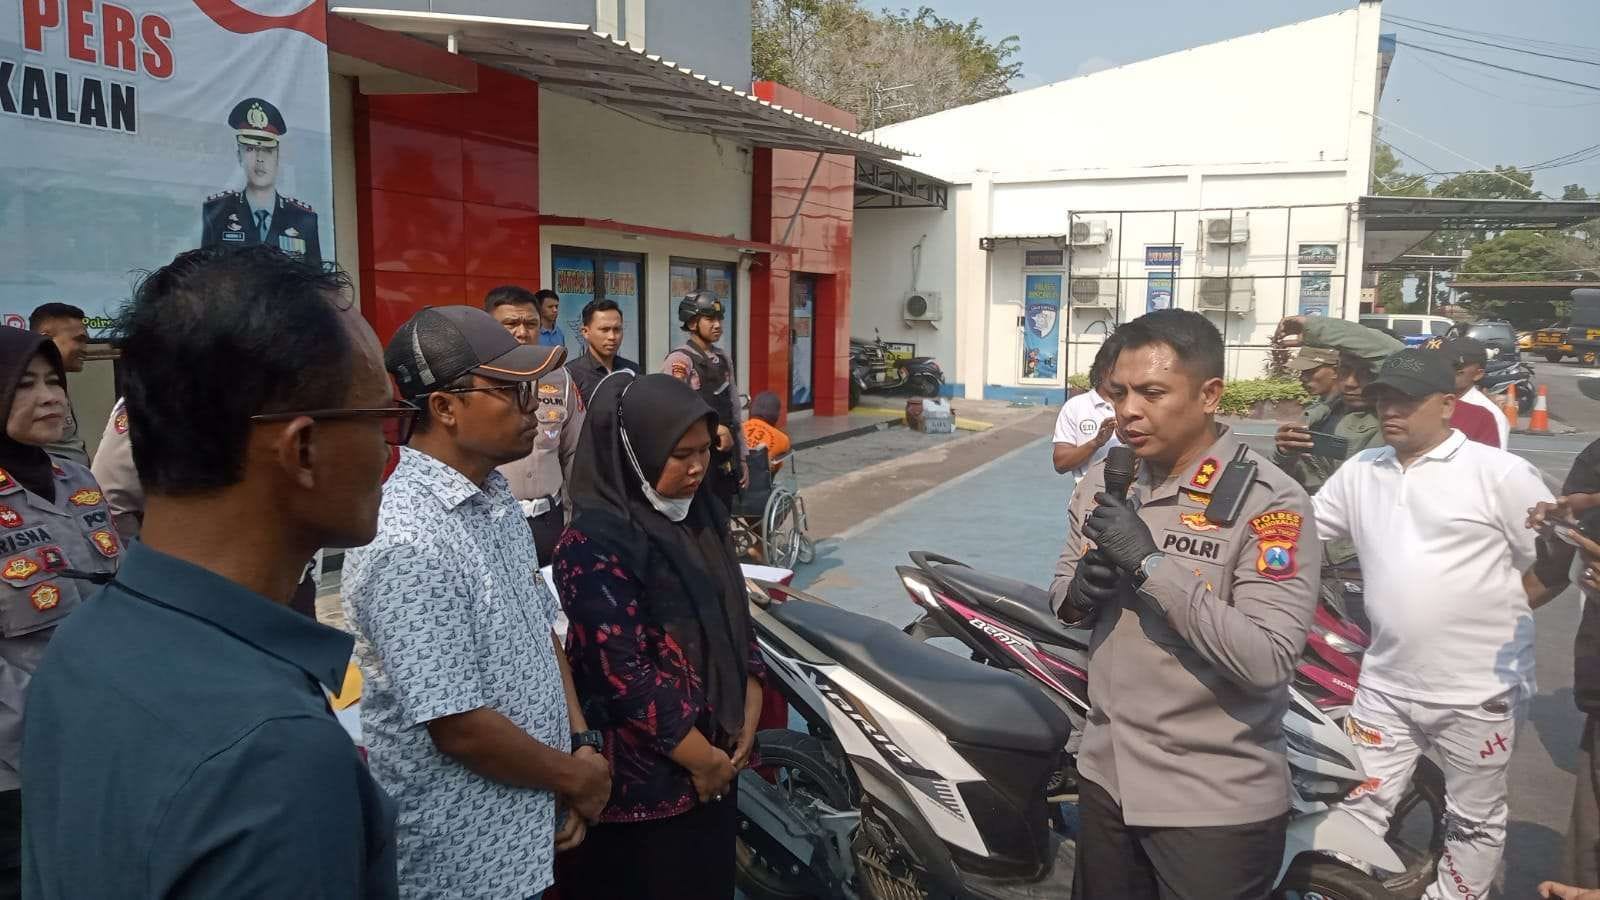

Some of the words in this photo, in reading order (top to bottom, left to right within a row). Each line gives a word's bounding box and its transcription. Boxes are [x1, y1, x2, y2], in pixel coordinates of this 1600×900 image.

[22, 0, 175, 80] PERS
[1163, 533, 1220, 560] POLRI
[1252, 512, 1301, 531] POLRES
[796, 663, 913, 763] VARIO
